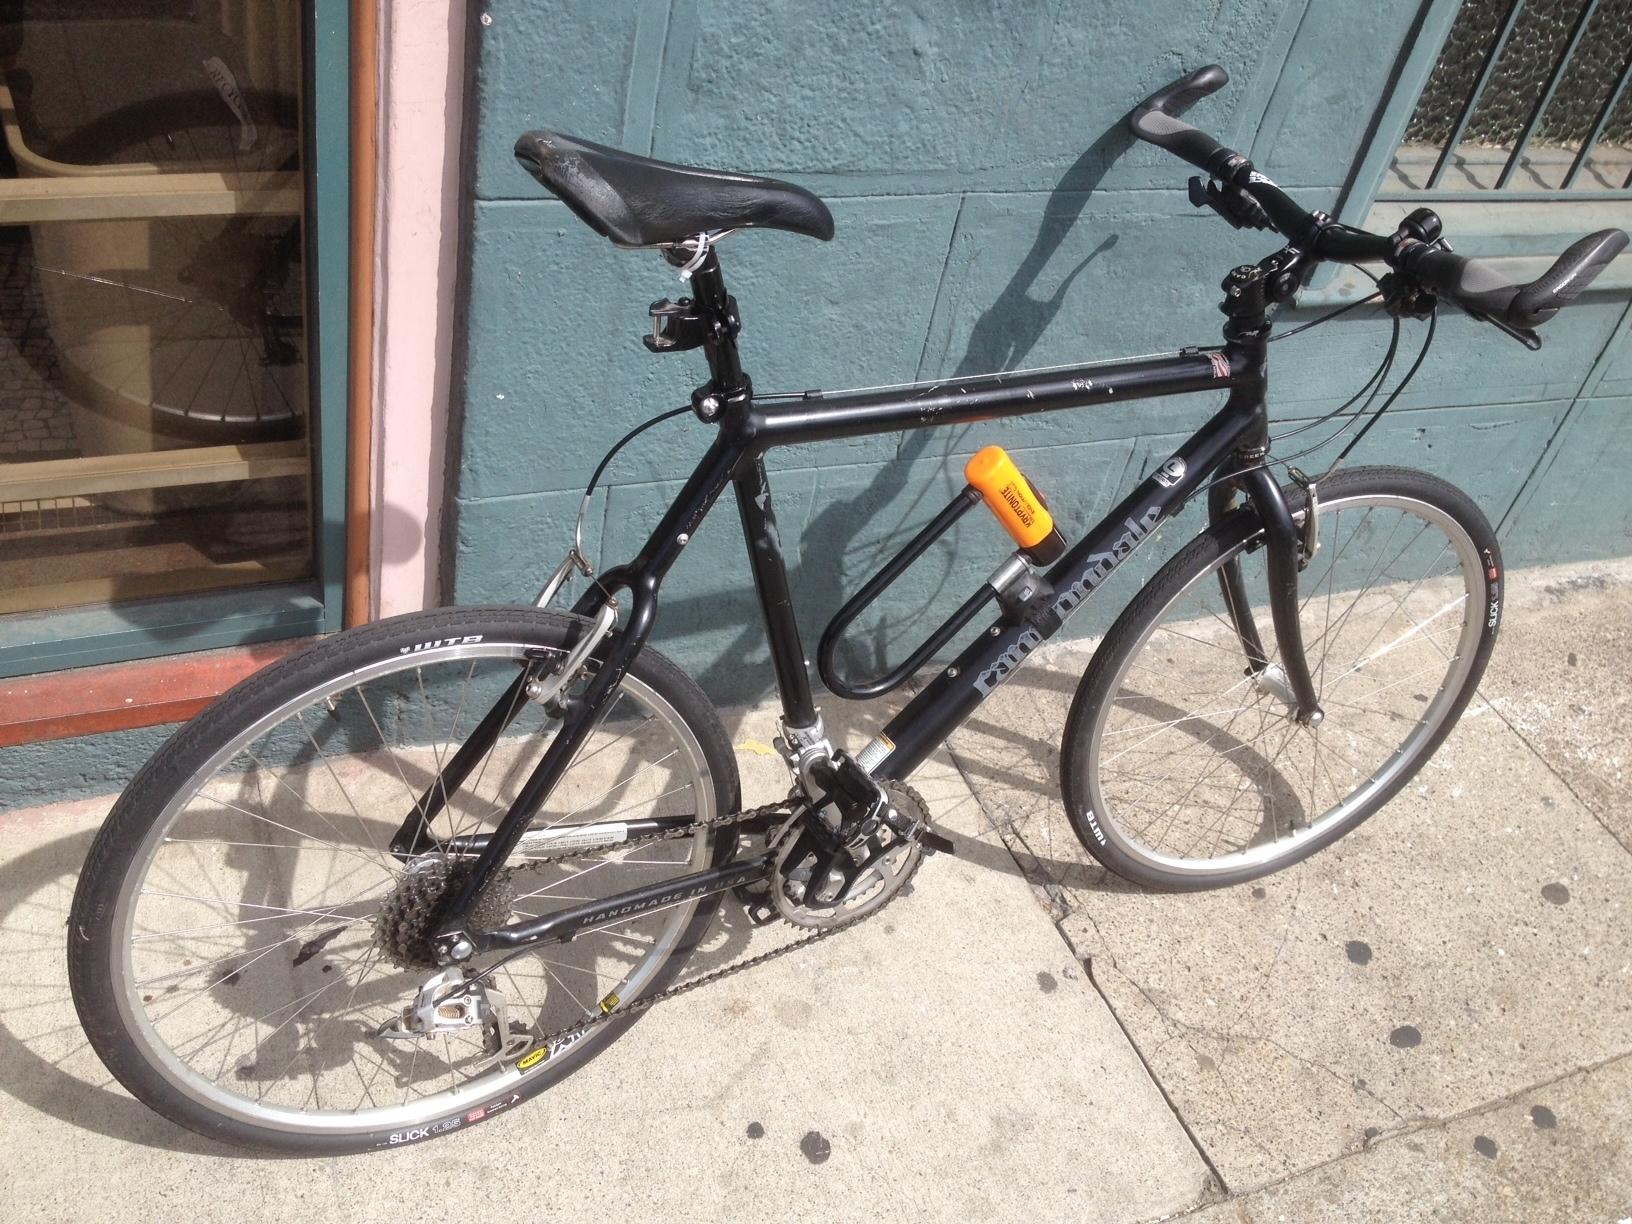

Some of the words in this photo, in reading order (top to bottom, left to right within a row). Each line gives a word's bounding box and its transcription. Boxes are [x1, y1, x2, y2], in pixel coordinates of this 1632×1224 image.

[1001, 486, 1031, 528] KRYPTONITE
[973, 506, 1161, 698] canondale
[413, 634, 484, 653] WTB
[1086, 810, 1105, 841] WTB
[582, 892, 683, 925] HANDMADE
[691, 886, 707, 896] IN
[389, 1126, 429, 1145] SLICK
